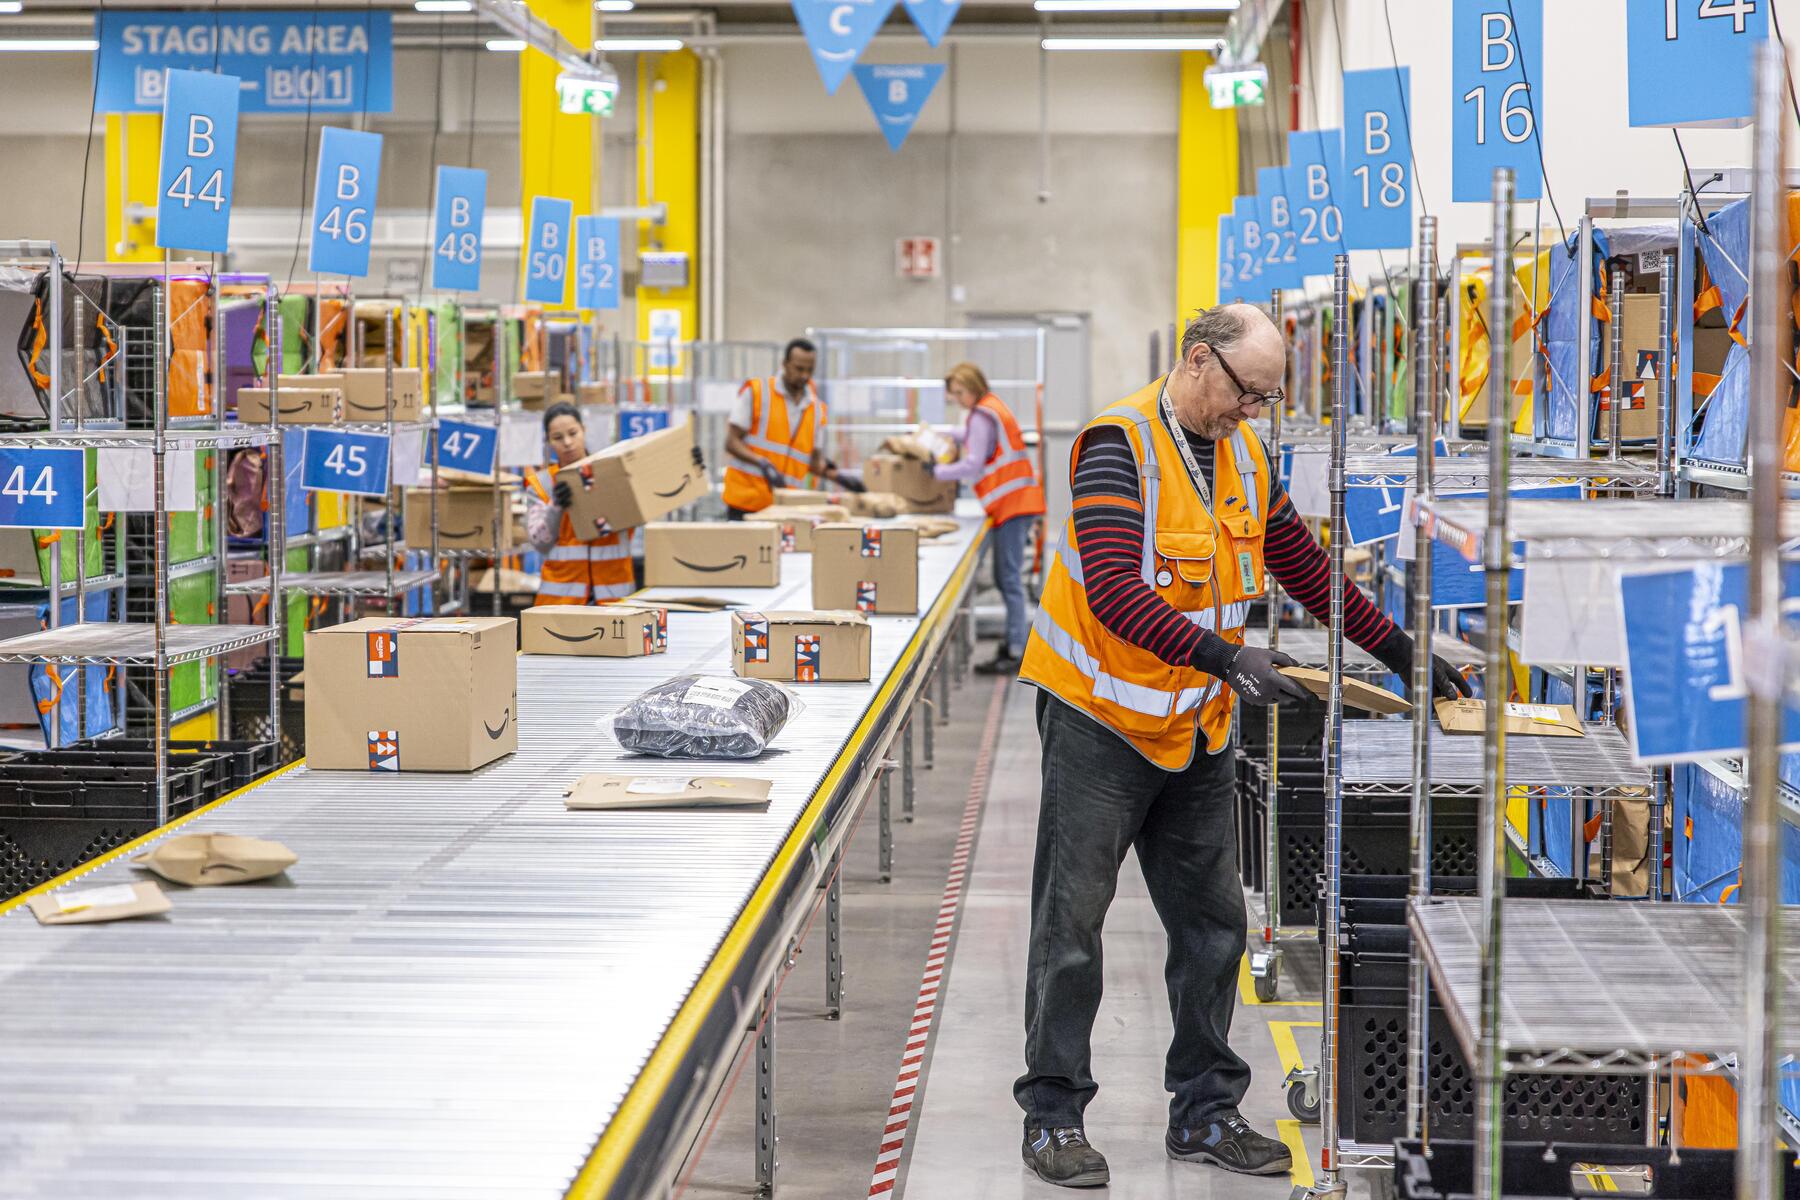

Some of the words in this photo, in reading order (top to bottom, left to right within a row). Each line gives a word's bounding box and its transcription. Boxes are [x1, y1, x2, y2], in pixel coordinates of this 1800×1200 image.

[829, 5, 854, 36] C
[122, 25, 270, 54] STAGING
[280, 26, 369, 54] AREA
[1480, 11, 1516, 72] B
[273, 69, 344, 97] B01
[888, 79, 908, 104] B
[1463, 82, 1534, 145] 16
[187, 113, 215, 158] B
[1364, 110, 1391, 155] B
[166, 166, 226, 212] 44
[337, 164, 360, 200] B
[1307, 164, 1329, 201] B
[1353, 162, 1406, 208] 18
[319, 206, 367, 244] 46
[451, 196, 470, 228] B
[1271, 196, 1290, 228] B
[1299, 205, 1343, 244] 20
[437, 232, 478, 264] 48
[541, 222, 559, 249] B
[588, 237, 606, 261] B
[1244, 221, 1261, 249] B
[1264, 231, 1296, 263] 22
[532, 252, 563, 281] 50
[581, 264, 613, 289] 52
[324, 444, 367, 477] 45
[442, 431, 481, 460] 47
[1, 465, 58, 505] 44
